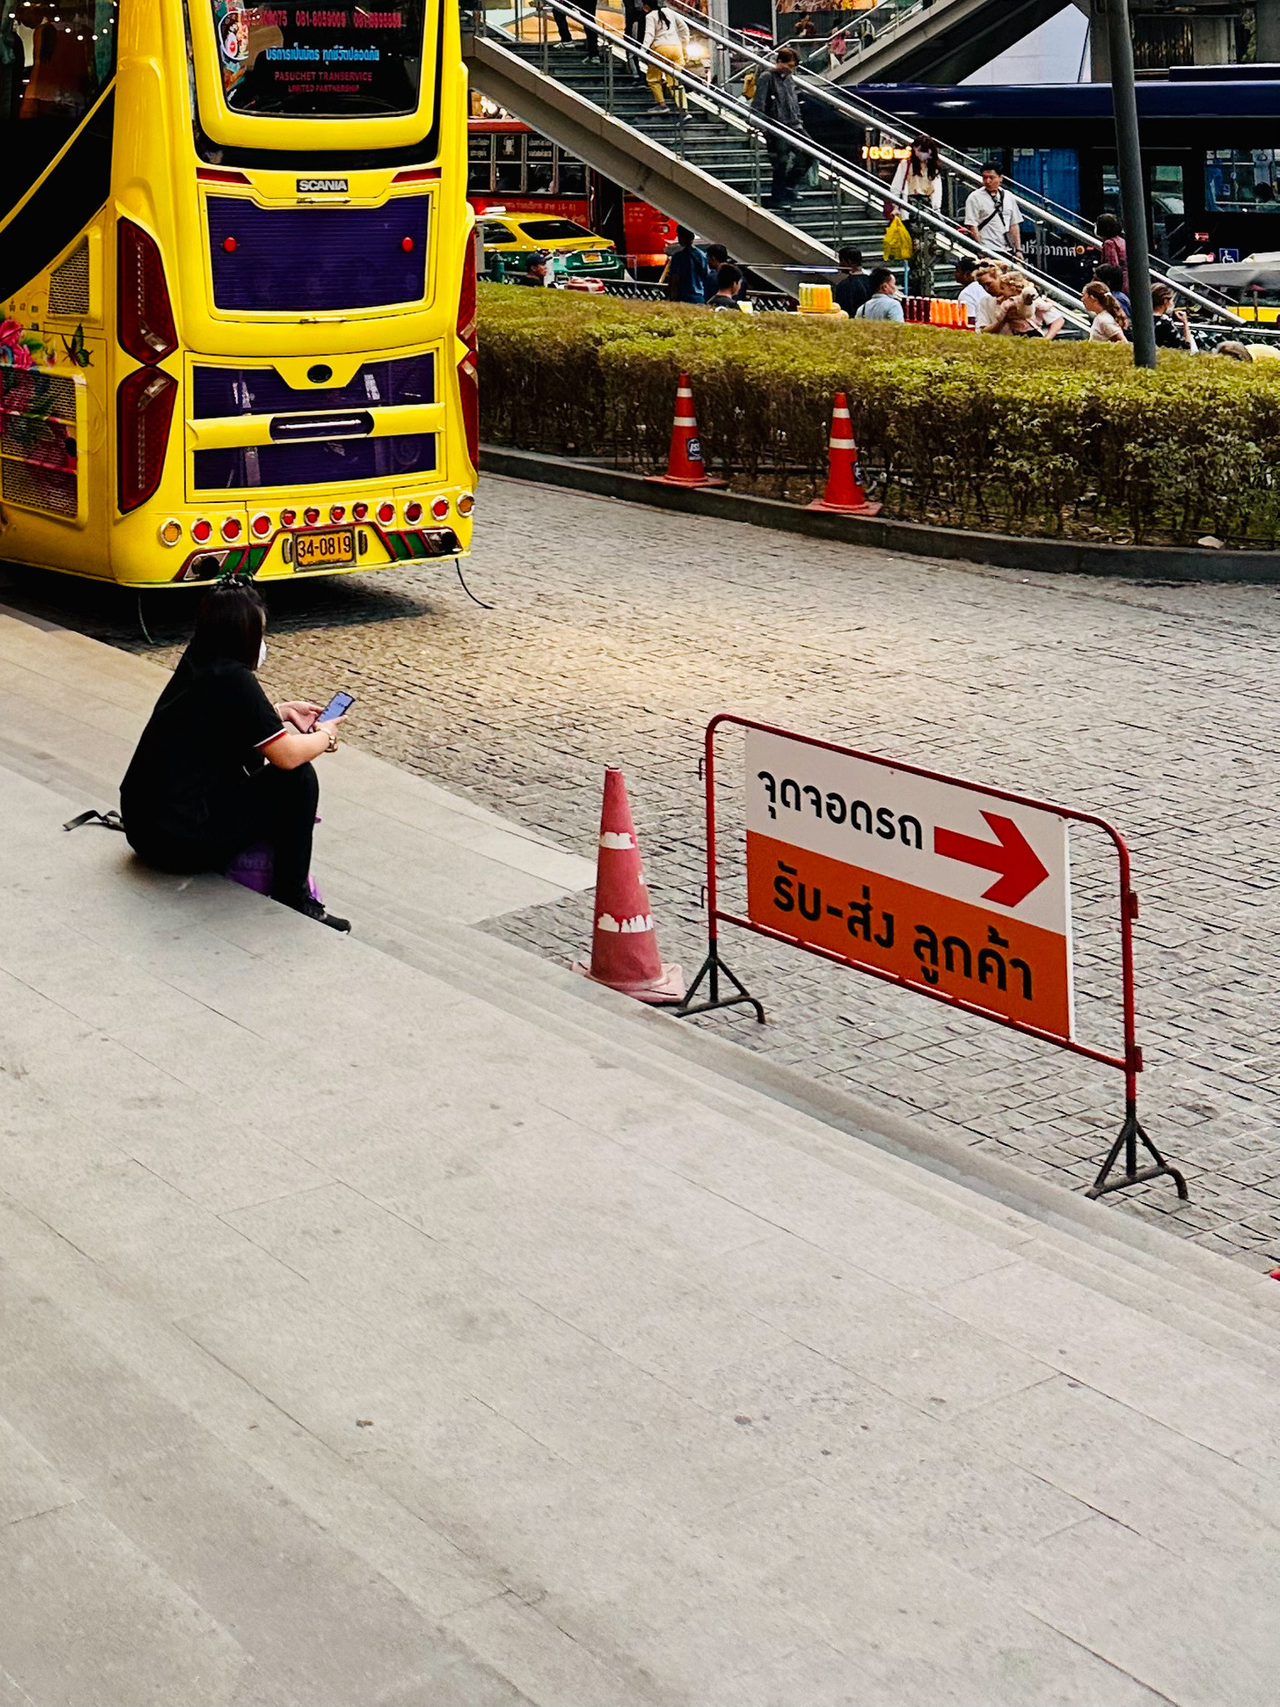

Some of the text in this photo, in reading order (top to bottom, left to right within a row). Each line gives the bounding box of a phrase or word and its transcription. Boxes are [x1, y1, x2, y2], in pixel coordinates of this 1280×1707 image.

[274, 71, 373, 81] PASUCHET TRANSERVICE
[298, 179, 348, 191] SCANIA
[297, 535, 351, 558] 34-0819
[757, 770, 923, 850] จุดจอดรถ
[772, 860, 1033, 1001] รับ-ส่ง ลูกค้า
